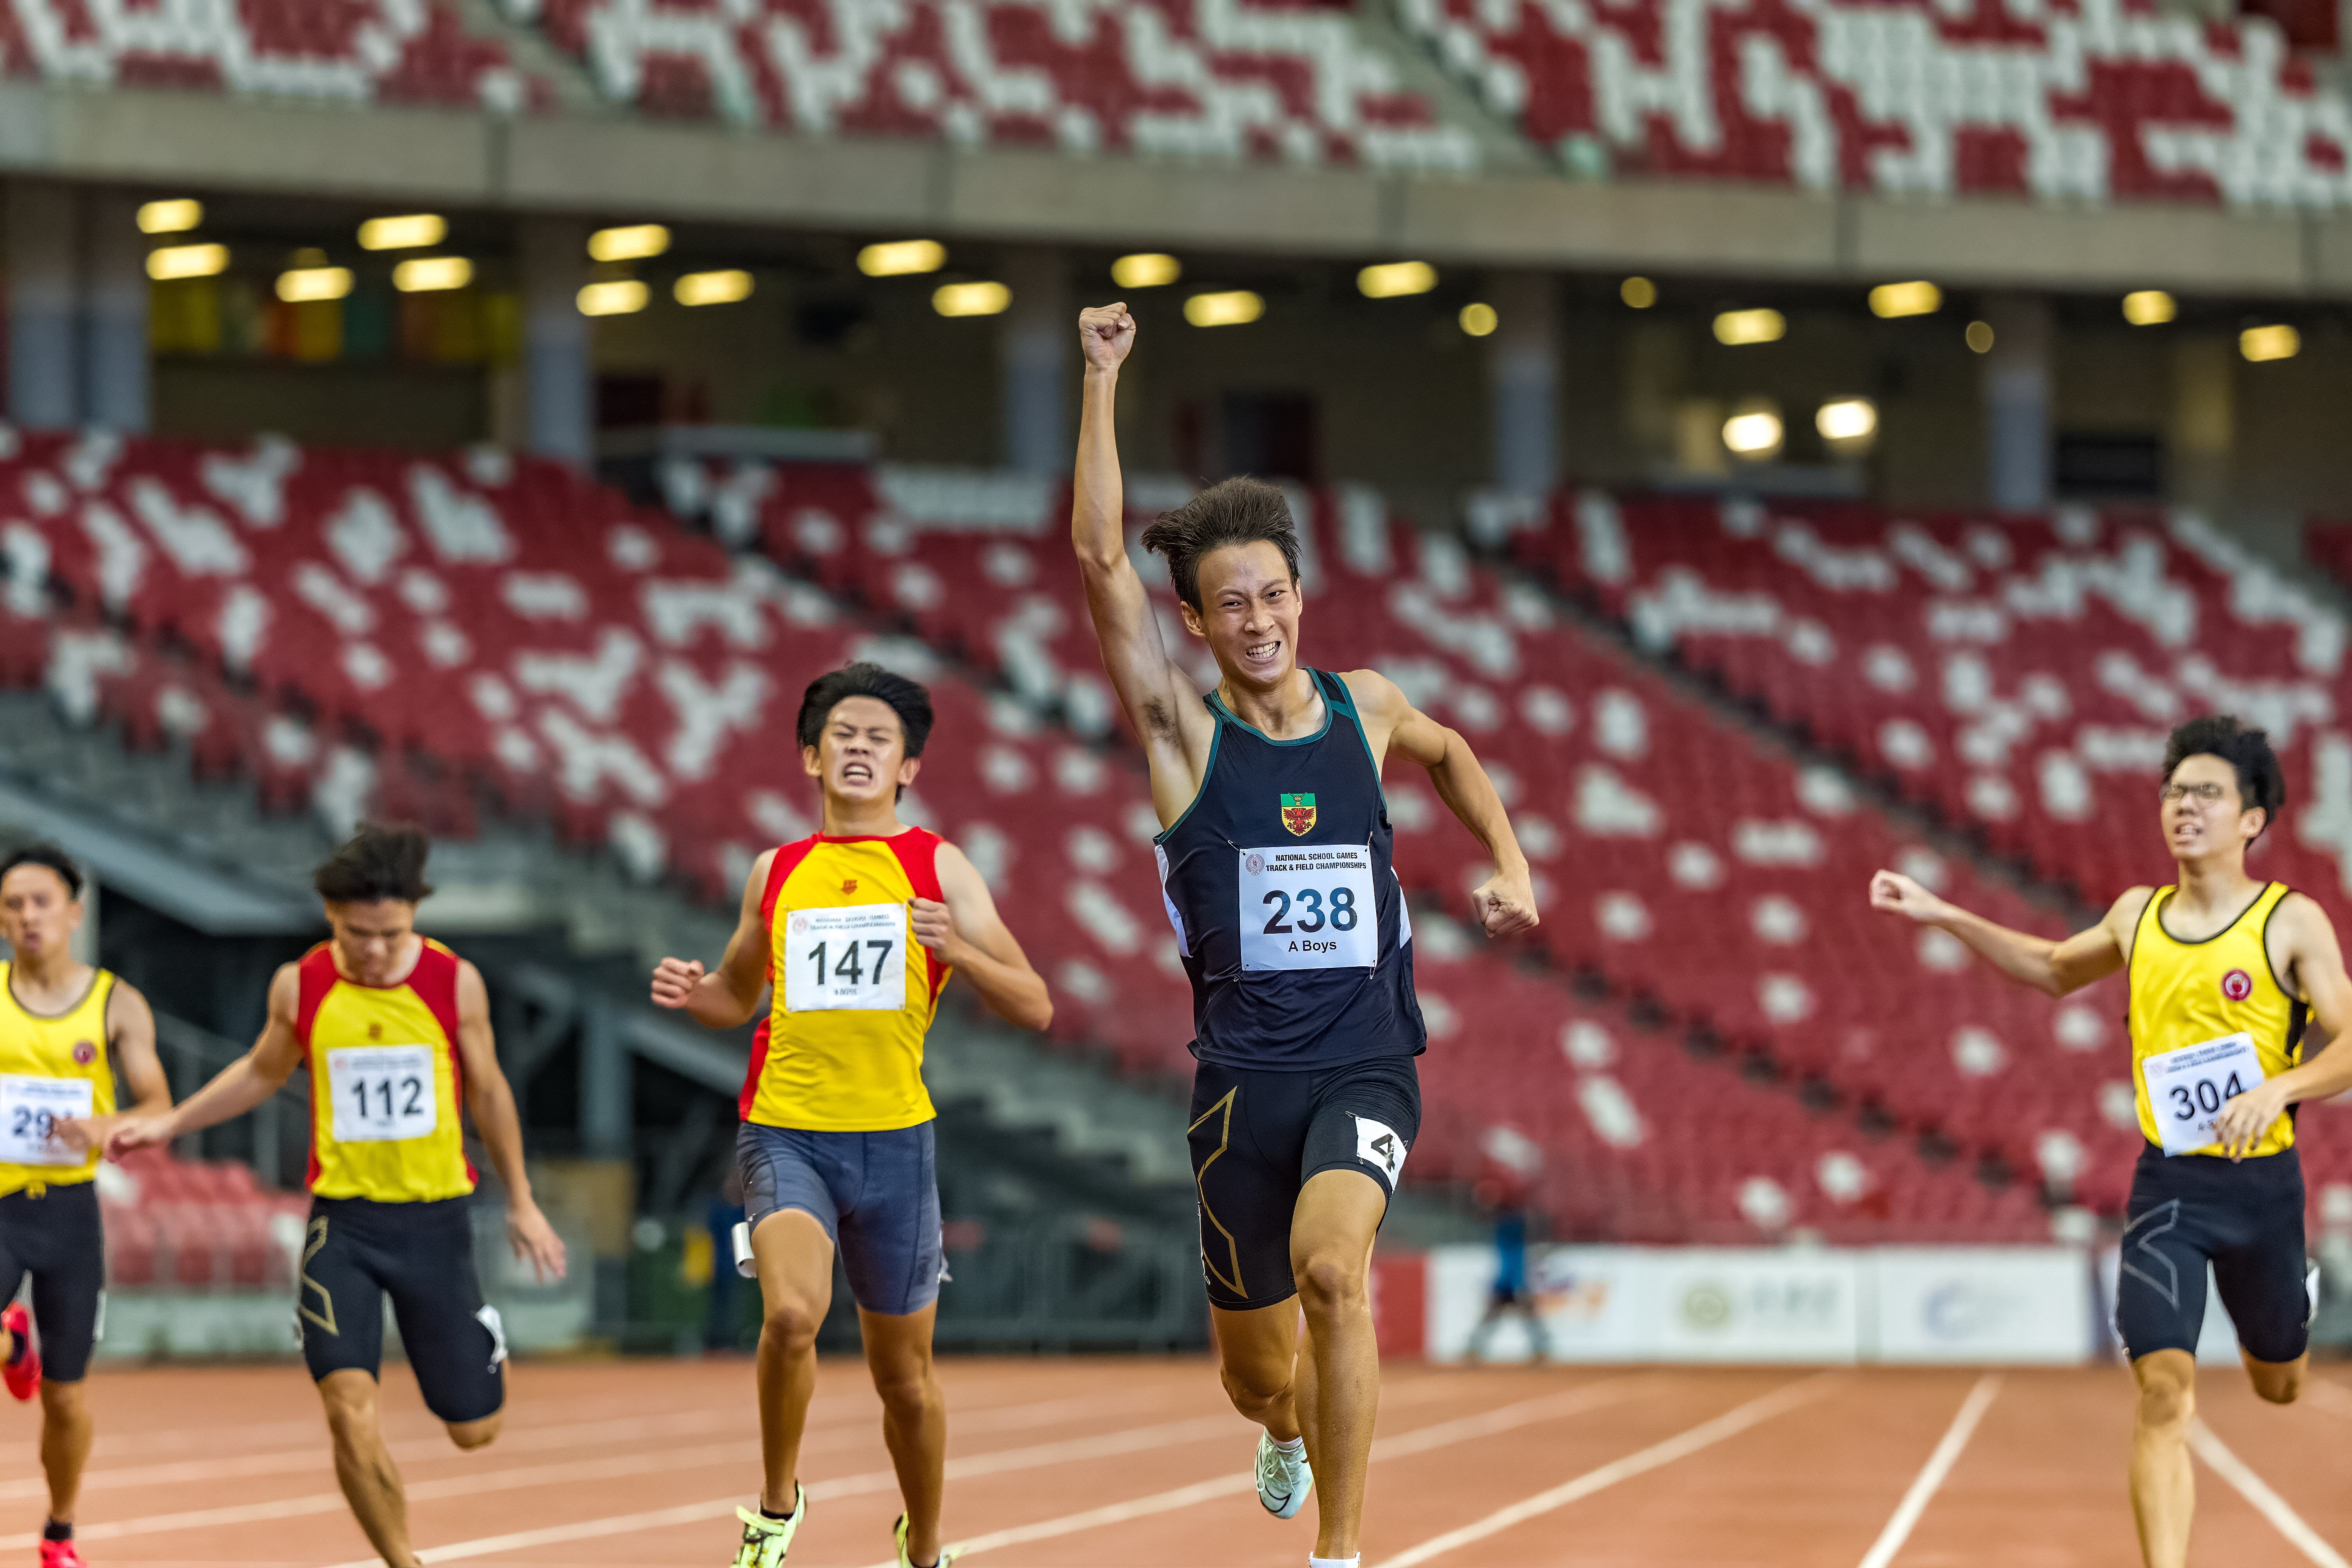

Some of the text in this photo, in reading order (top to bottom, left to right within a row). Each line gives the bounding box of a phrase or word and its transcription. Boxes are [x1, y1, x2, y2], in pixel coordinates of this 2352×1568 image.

[1263, 887, 1357, 934] 238
[808, 940, 893, 985] 147
[1289, 940, 1337, 953] A Boys
[351, 1076, 424, 1118] 112
[2169, 1070, 2246, 1120] 304
[12, 1105, 73, 1138] 29
